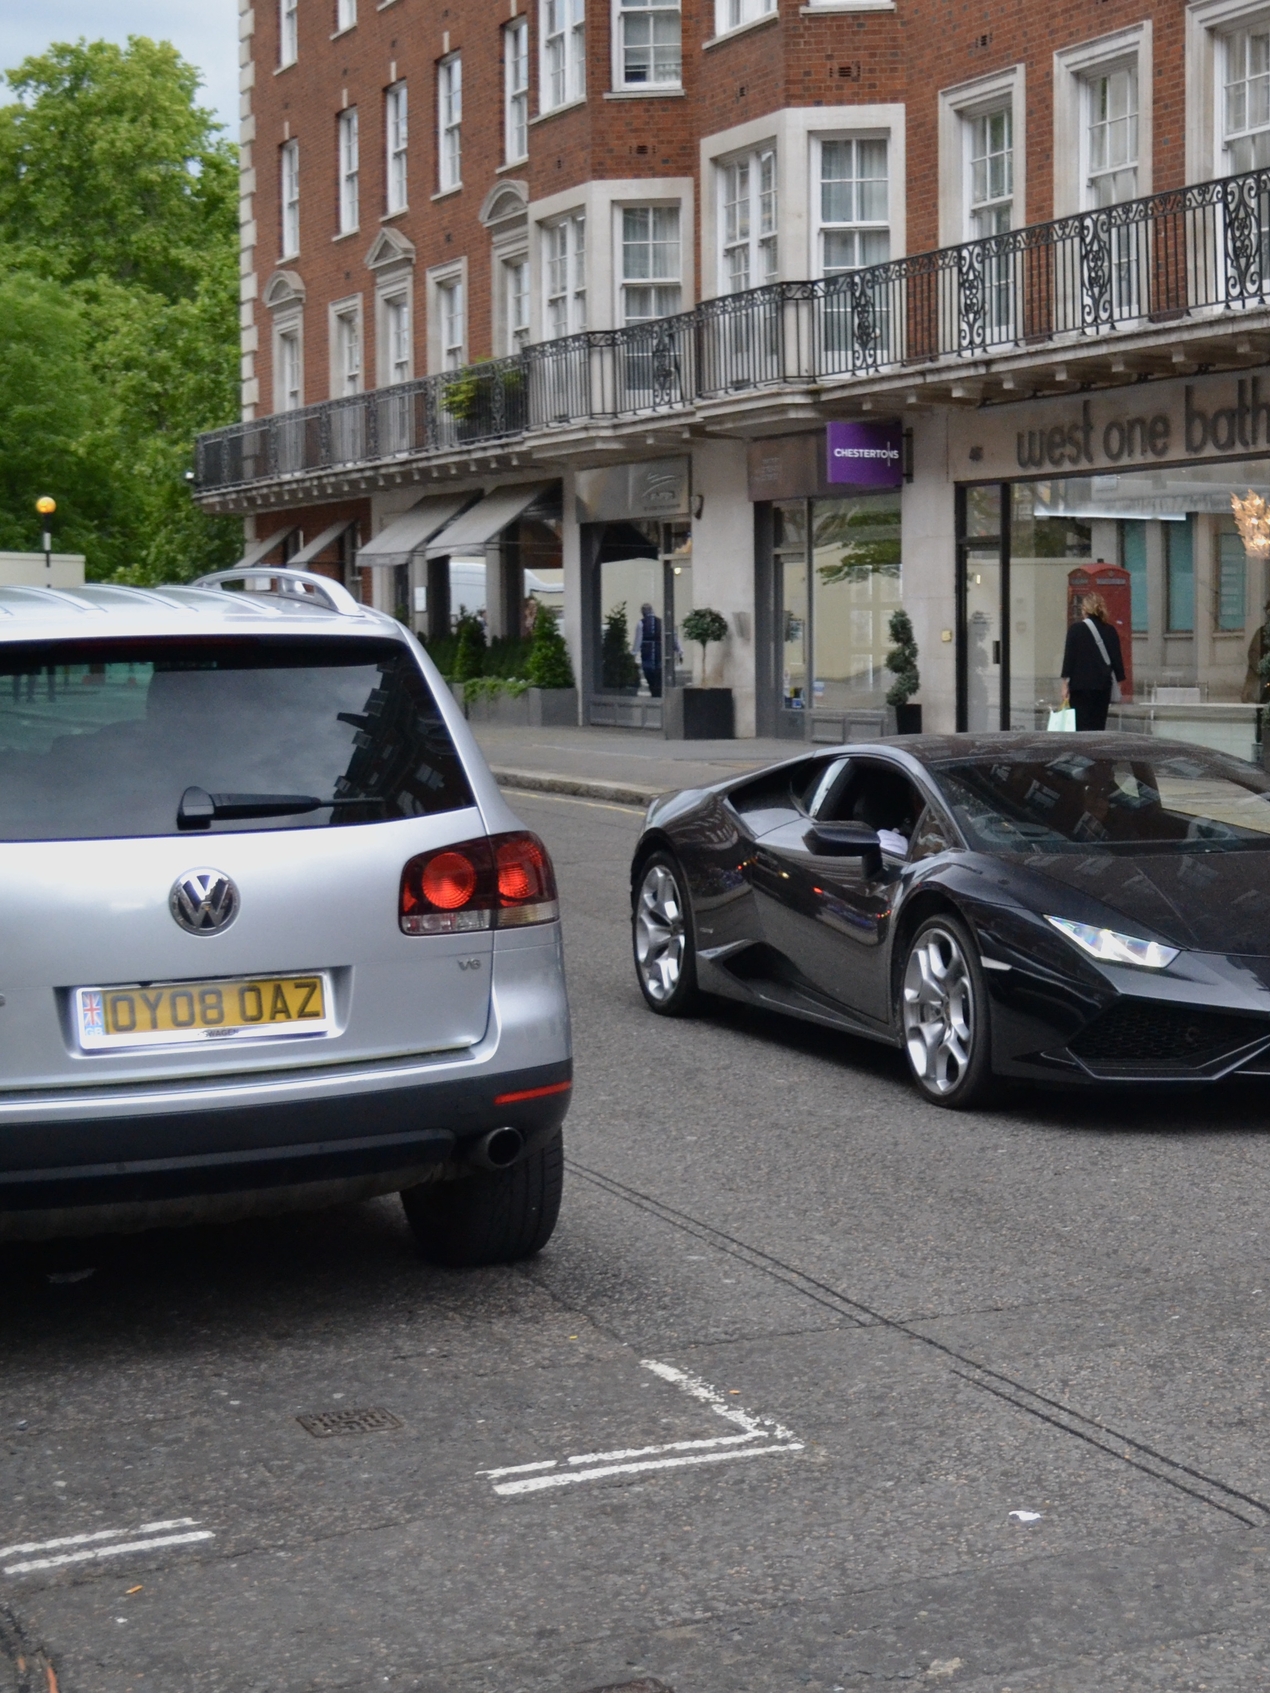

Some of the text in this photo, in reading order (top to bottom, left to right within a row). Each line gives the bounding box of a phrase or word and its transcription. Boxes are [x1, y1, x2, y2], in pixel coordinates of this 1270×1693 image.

[833, 448, 899, 459] CHESTERTONS
[1017, 400, 1094, 469] west
[1103, 415, 1171, 462] one
[239, 981, 321, 1023] OAZ
